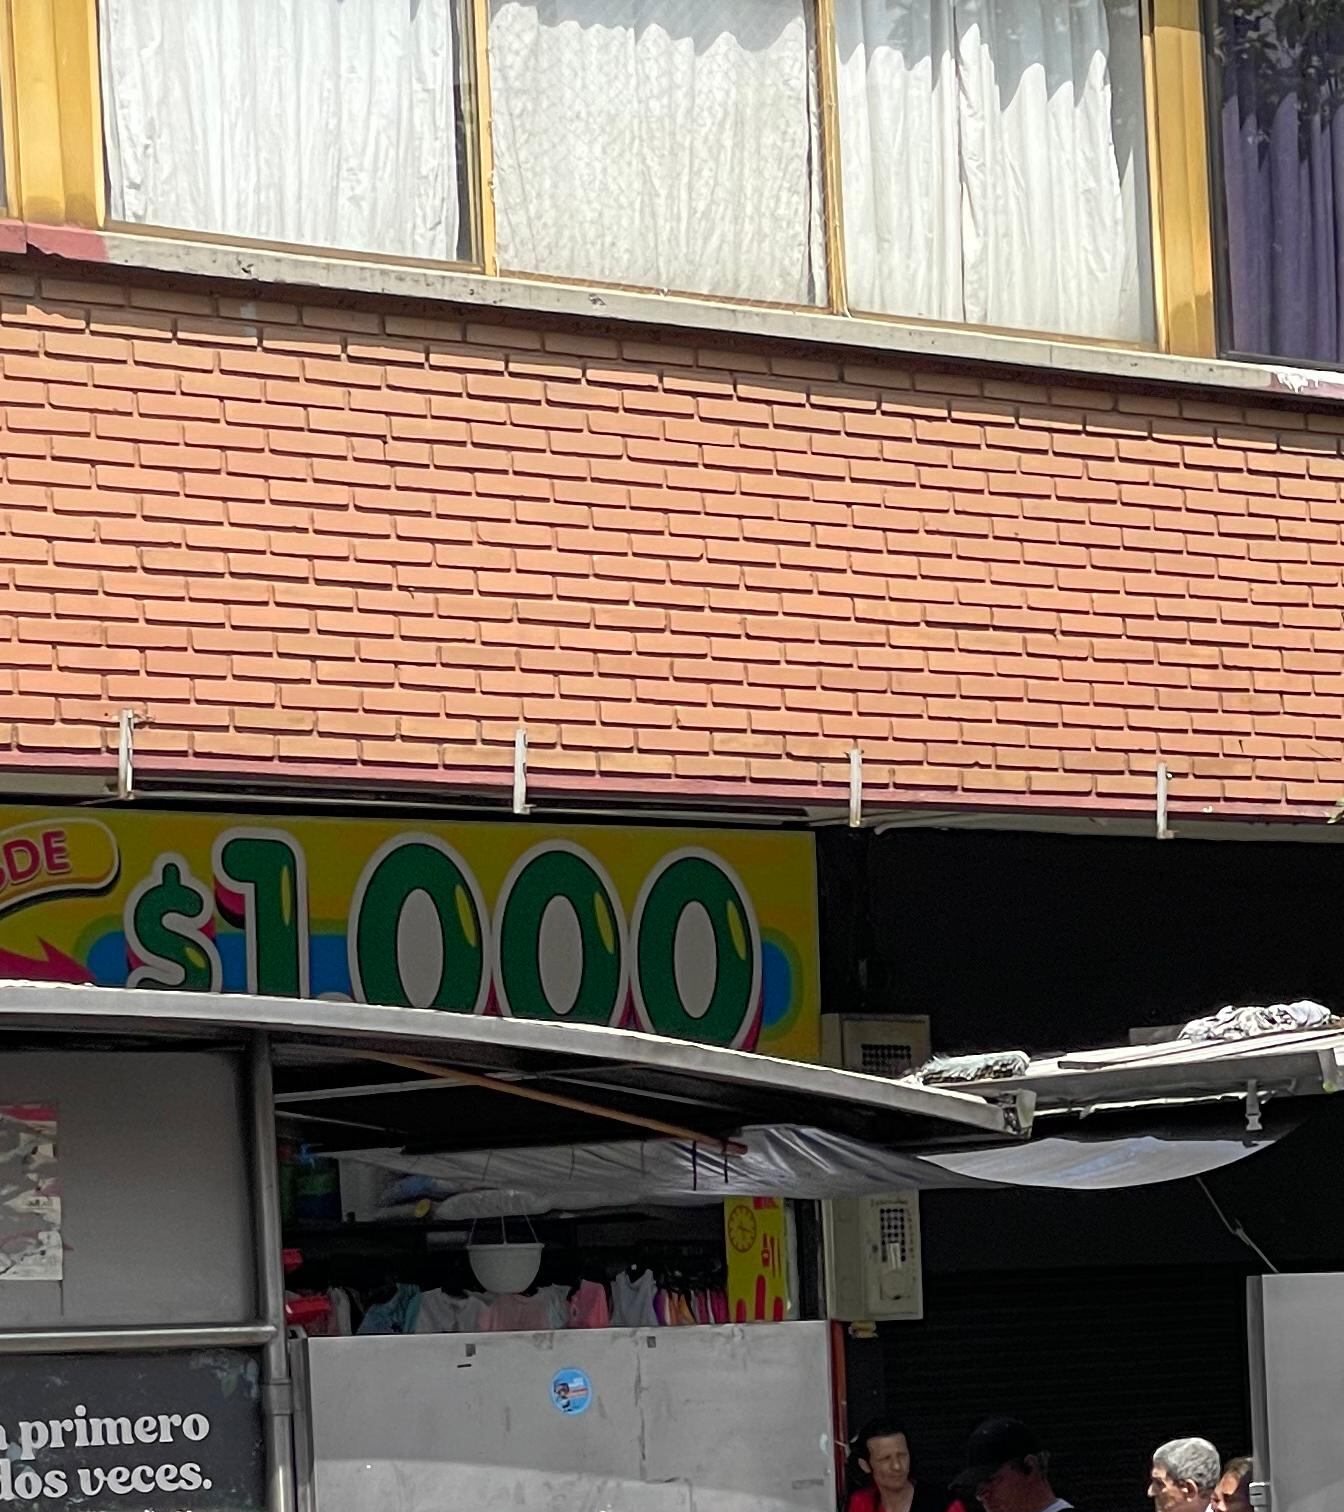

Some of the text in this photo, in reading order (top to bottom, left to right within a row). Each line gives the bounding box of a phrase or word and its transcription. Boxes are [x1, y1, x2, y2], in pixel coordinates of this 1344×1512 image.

[124, 826, 763, 1050] $1000
[18, 1403, 211, 1461] primero
[77, 1462, 213, 1497] veces.
